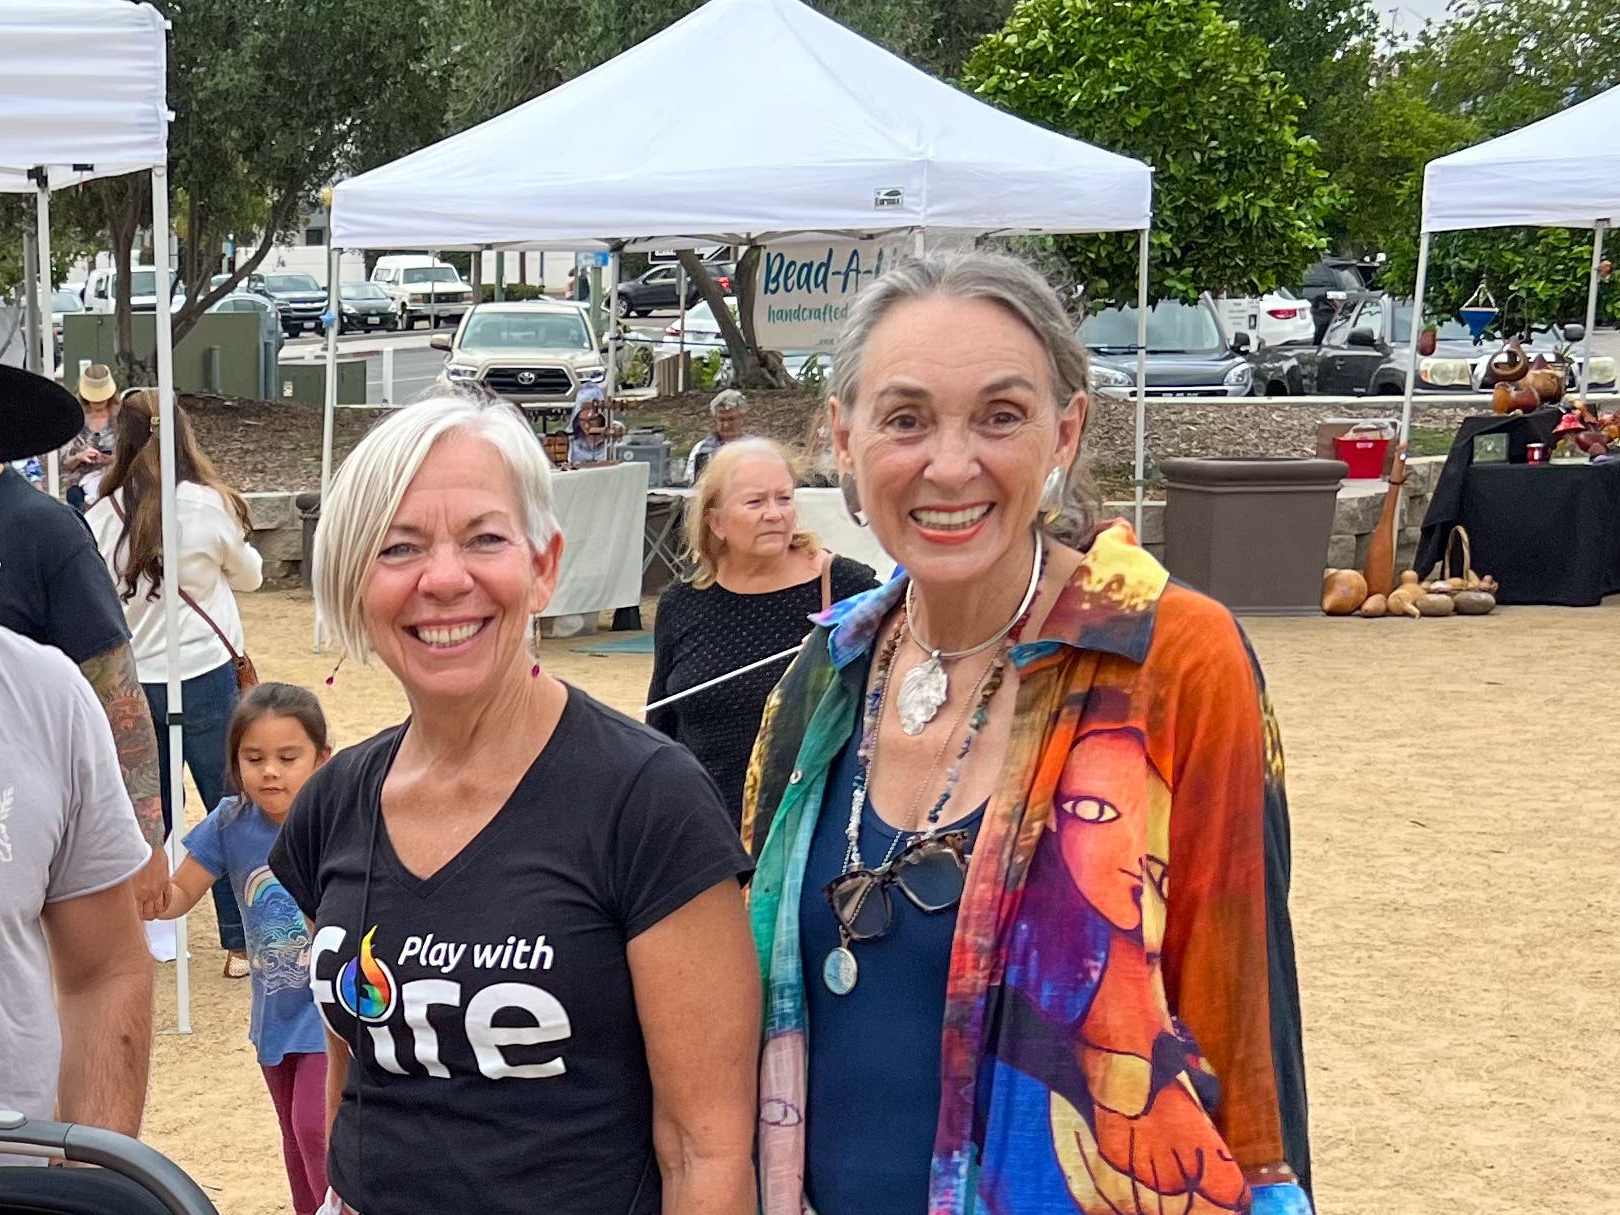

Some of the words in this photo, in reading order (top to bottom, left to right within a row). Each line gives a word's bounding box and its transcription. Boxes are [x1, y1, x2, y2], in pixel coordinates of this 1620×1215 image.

[767, 303, 850, 324] handcrafted
[397, 933, 467, 973] Play
[474, 935, 555, 970] with
